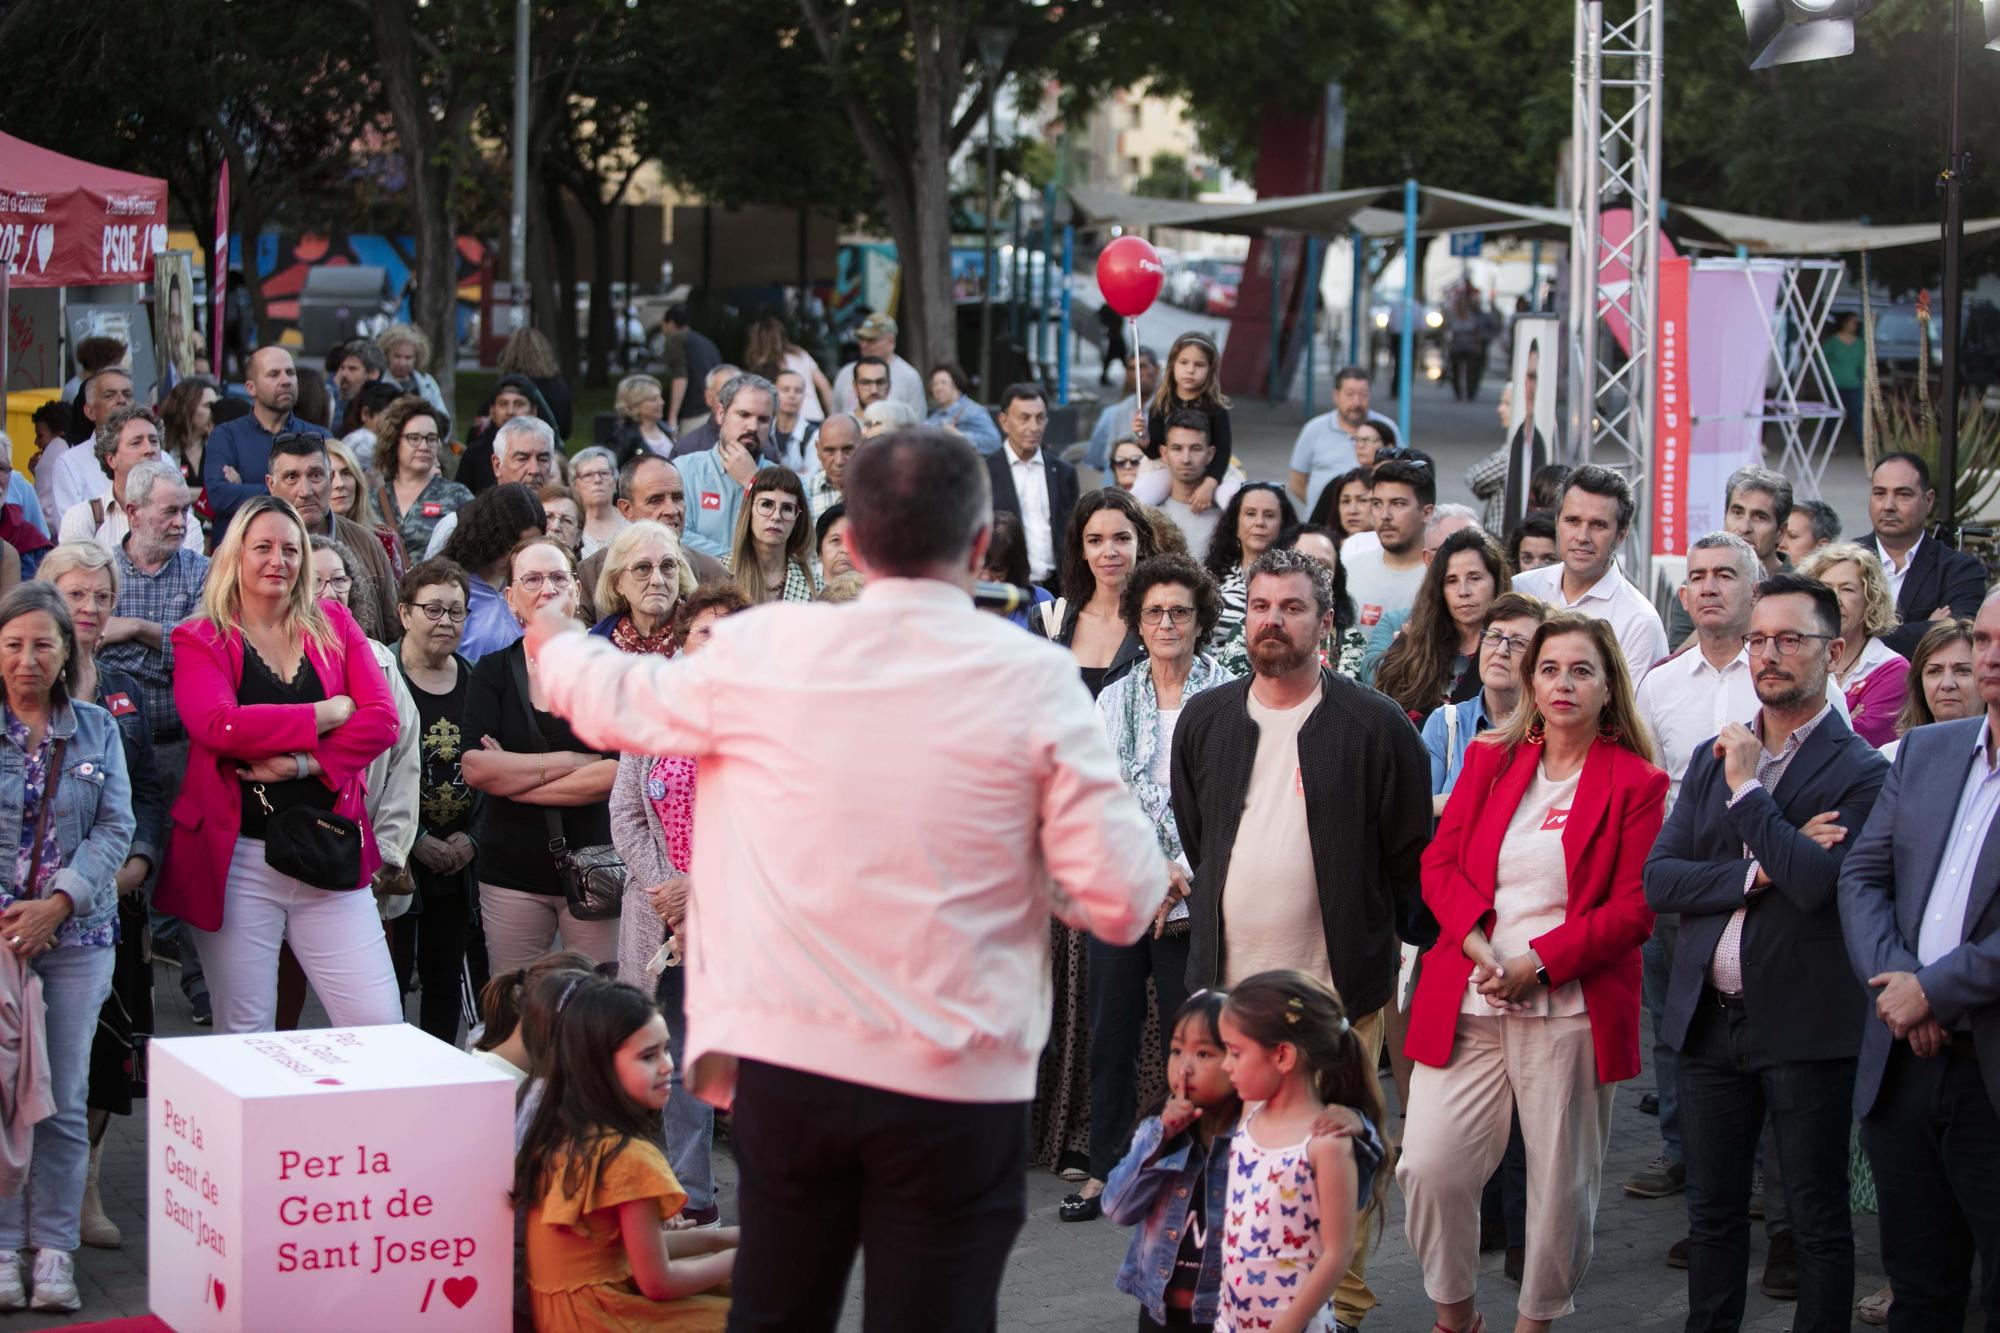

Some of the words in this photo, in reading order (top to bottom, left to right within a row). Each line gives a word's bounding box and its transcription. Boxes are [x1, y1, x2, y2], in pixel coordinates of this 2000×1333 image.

[102, 224, 138, 273] PSOE
[1660, 436, 1677, 556] ocialistes
[164, 1099, 187, 1139] Per
[191, 1116, 204, 1151] la
[165, 1145, 198, 1191] Gent
[201, 1171, 219, 1206] de
[278, 1150, 344, 1181] Per
[357, 1145, 392, 1176] la
[164, 1187, 195, 1234] Sant
[196, 1211, 227, 1258] Joan
[279, 1194, 373, 1227] Gent
[386, 1188, 434, 1219] de
[278, 1241, 360, 1273] Sant
[370, 1235, 477, 1274] Josep
